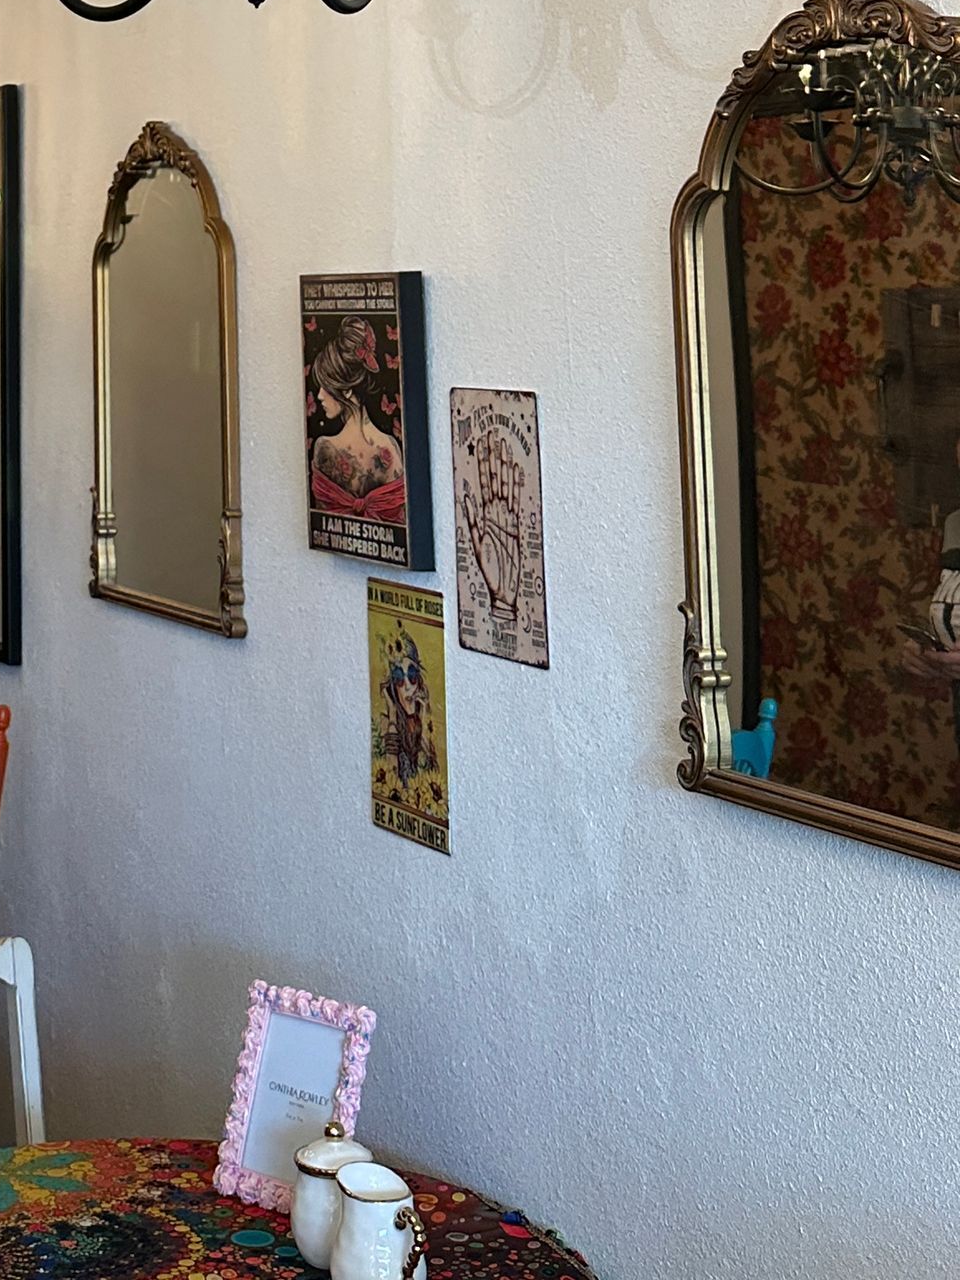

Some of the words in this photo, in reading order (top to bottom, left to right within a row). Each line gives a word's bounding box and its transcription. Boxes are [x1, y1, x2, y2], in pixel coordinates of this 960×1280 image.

[323, 283, 365, 297] WHISPERED
[366, 282, 377, 297] TO
[378, 281, 394, 296] HER
[321, 516, 326, 530] I
[327, 518, 343, 533] AM
[343, 520, 361, 537] THE
[362, 523, 394, 543] STORM
[313, 530, 330, 546] SHE
[330, 533, 380, 556] WHISPERED
[380, 543, 406, 562] BACK
[374, 587, 380, 601] A
[380, 589, 400, 607] WORLD
[400, 594, 416, 611] FULL
[415, 597, 424, 612] OF
[375, 802, 386, 824] BE
[387, 807, 395, 828] A
[396, 811, 447, 850] SUNFLOWER
